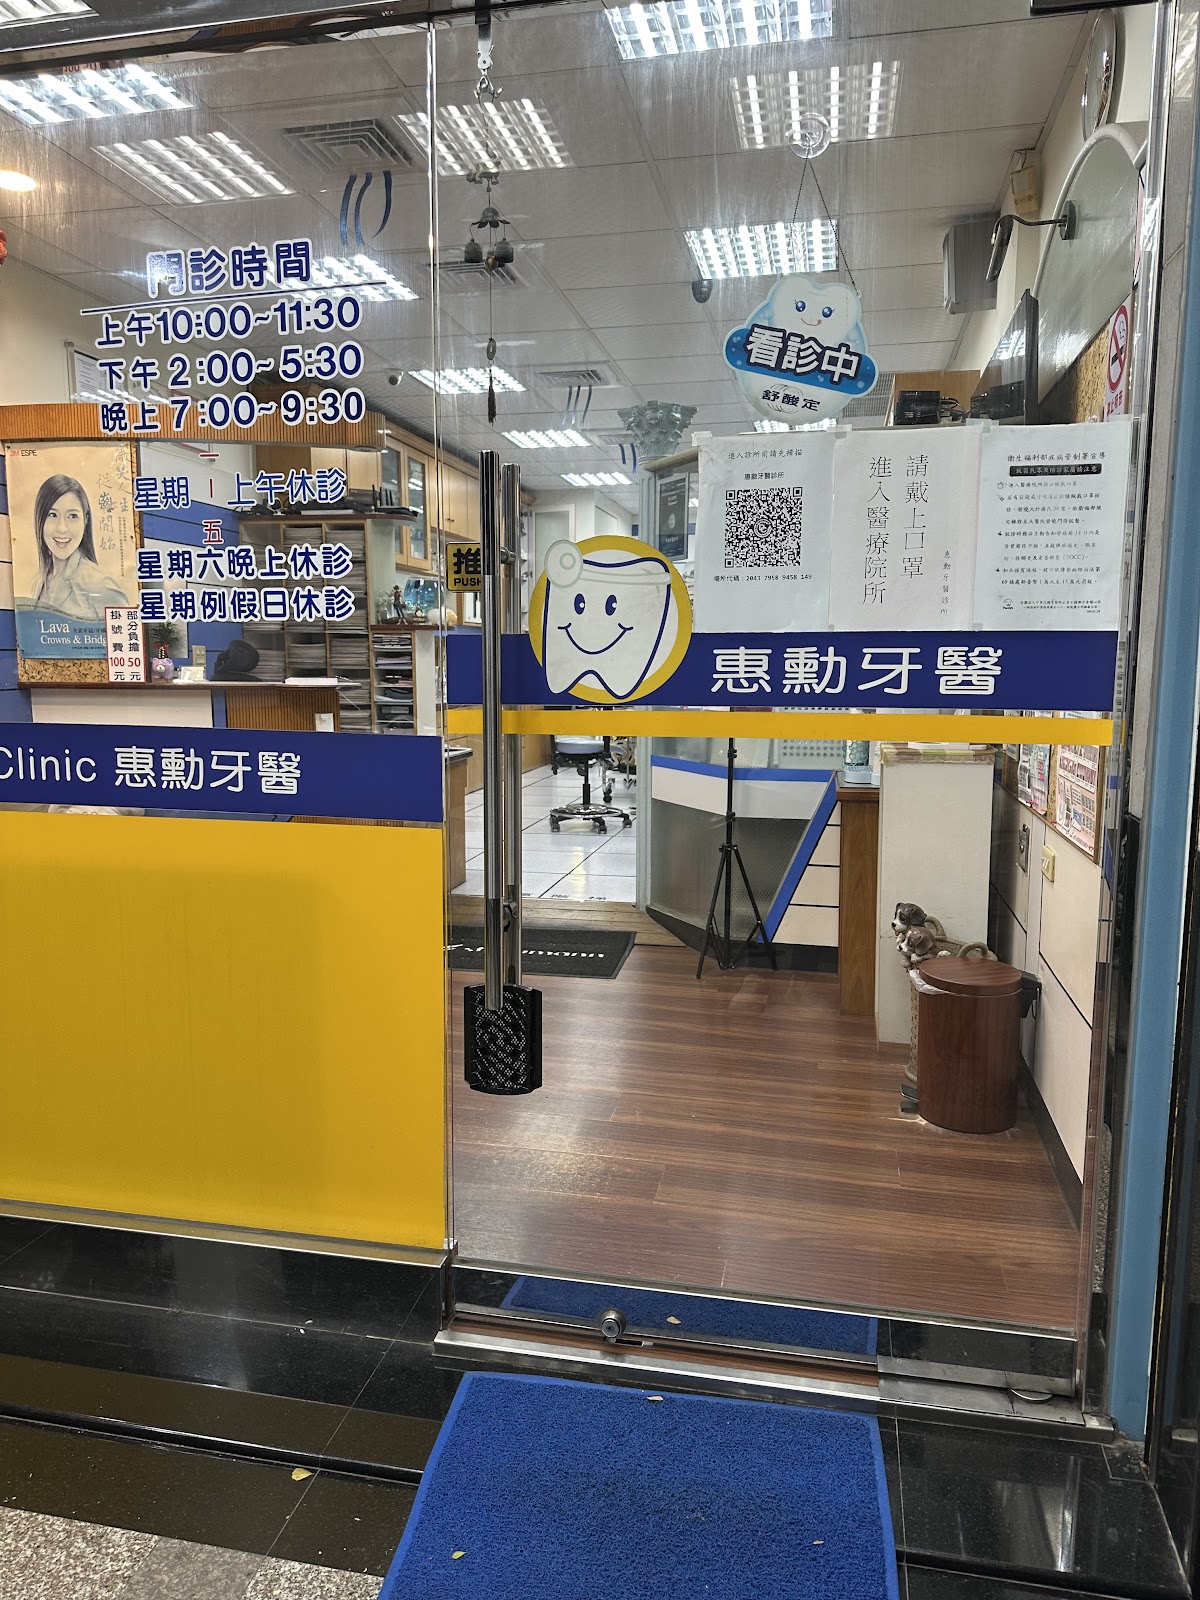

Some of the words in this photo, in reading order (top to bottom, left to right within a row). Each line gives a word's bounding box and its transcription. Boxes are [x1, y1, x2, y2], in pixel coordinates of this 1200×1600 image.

[148, 240, 312, 297] 門診時間
[746, 326, 860, 382] 看診中
[762, 389, 821, 412] 舒酸定
[10, 449, 20, 457] 3M
[21, 449, 38, 457] ESPE
[728, 448, 803, 460] 進入診所前請先掃描
[227, 468, 347, 508] 上午休診
[202, 519, 224, 545] 五
[863, 456, 892, 605] 進入醫療院所
[901, 454, 929, 579] 請戴上口罩
[137, 545, 353, 581] 星期六晚上休診
[453, 547, 482, 575] 推
[940, 550, 951, 616] 惠勳牙醫診所
[139, 585, 355, 623] 星期例假日休診
[39, 619, 70, 634] Lava
[40, 635, 71, 645] Crowns
[73, 634, 82, 645] &
[711, 645, 1004, 696] 惠勳牙醫
[0, 746, 97, 782] Clinic
[114, 744, 302, 795] 惠勳牙醫
